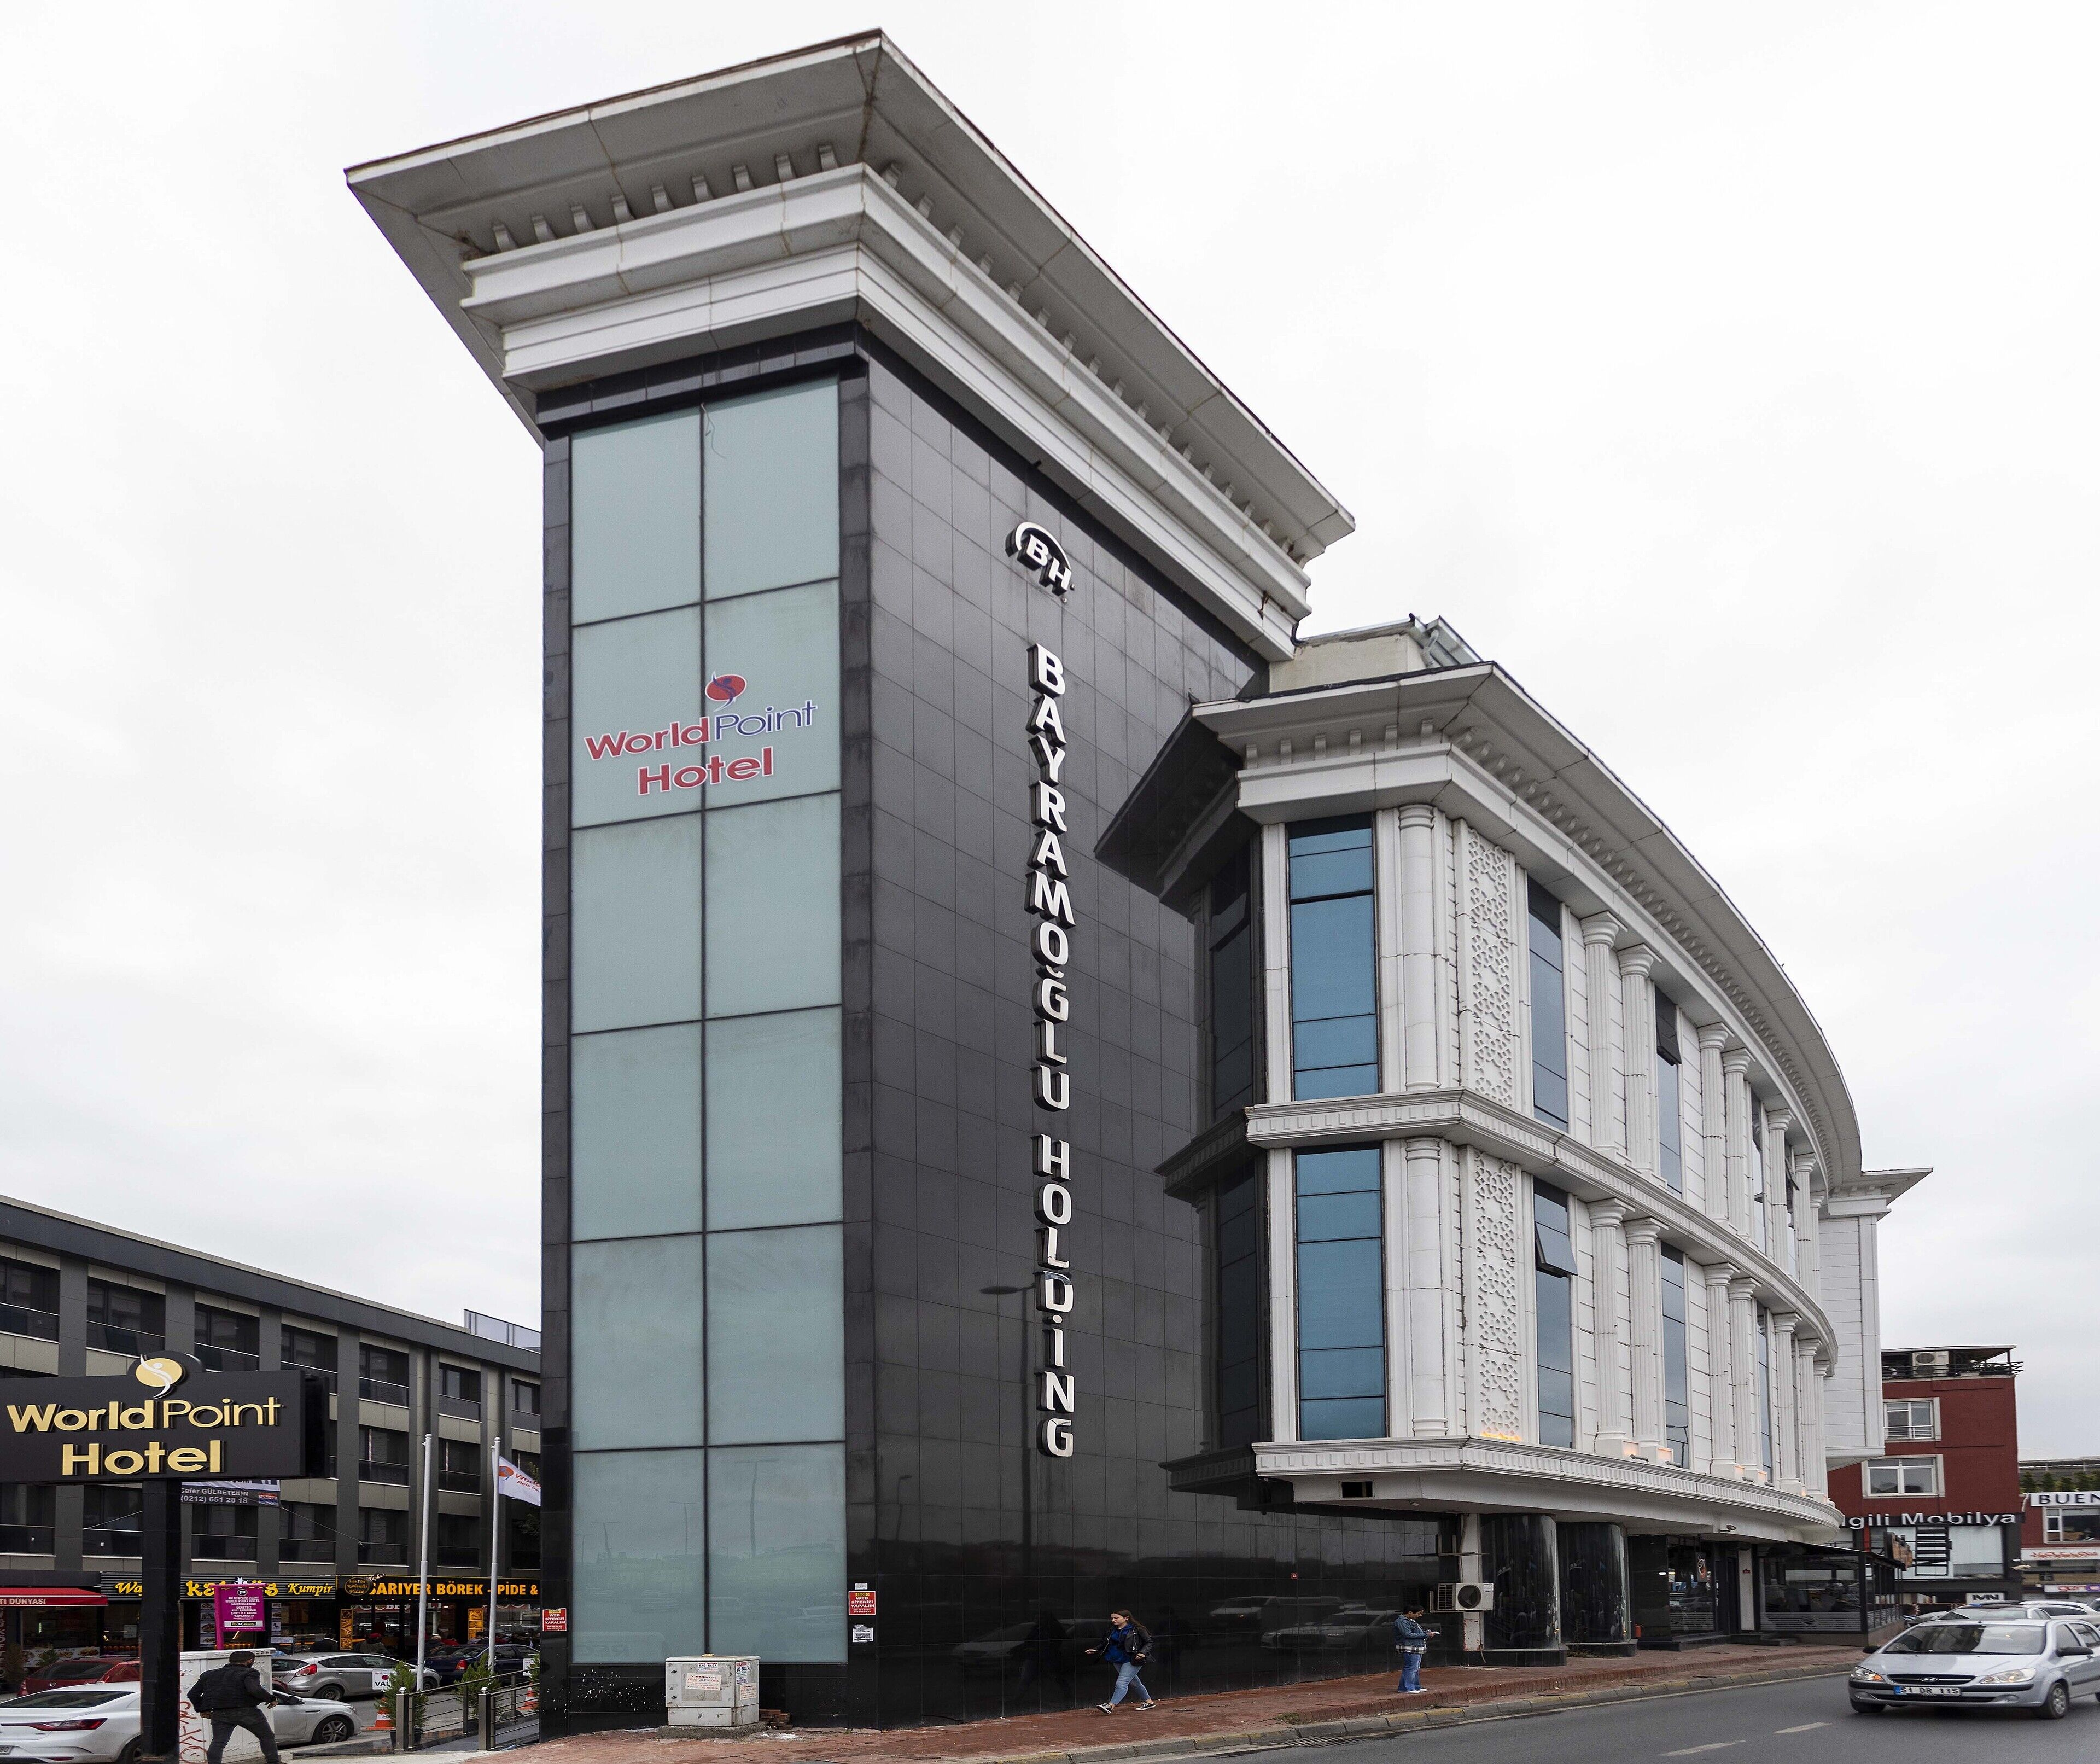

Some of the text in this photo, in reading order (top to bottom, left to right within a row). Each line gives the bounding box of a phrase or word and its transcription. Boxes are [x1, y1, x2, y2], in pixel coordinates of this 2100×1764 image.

[1023, 533, 1072, 592] BH
[638, 746, 773, 796] Hotel
[1030, 643, 1076, 1111] BAYRAMOĞLU
[62, 1440, 224, 1475] Hotel
[1901, 1511, 2016, 1527] Mobilya
[115, 1582, 142, 1596] Wa
[287, 1583, 333, 1596] Kumpir
[437, 1580, 483, 1595] BÖREK
[497, 1581, 526, 1595] PİDE
[530, 1585, 539, 1595] &
